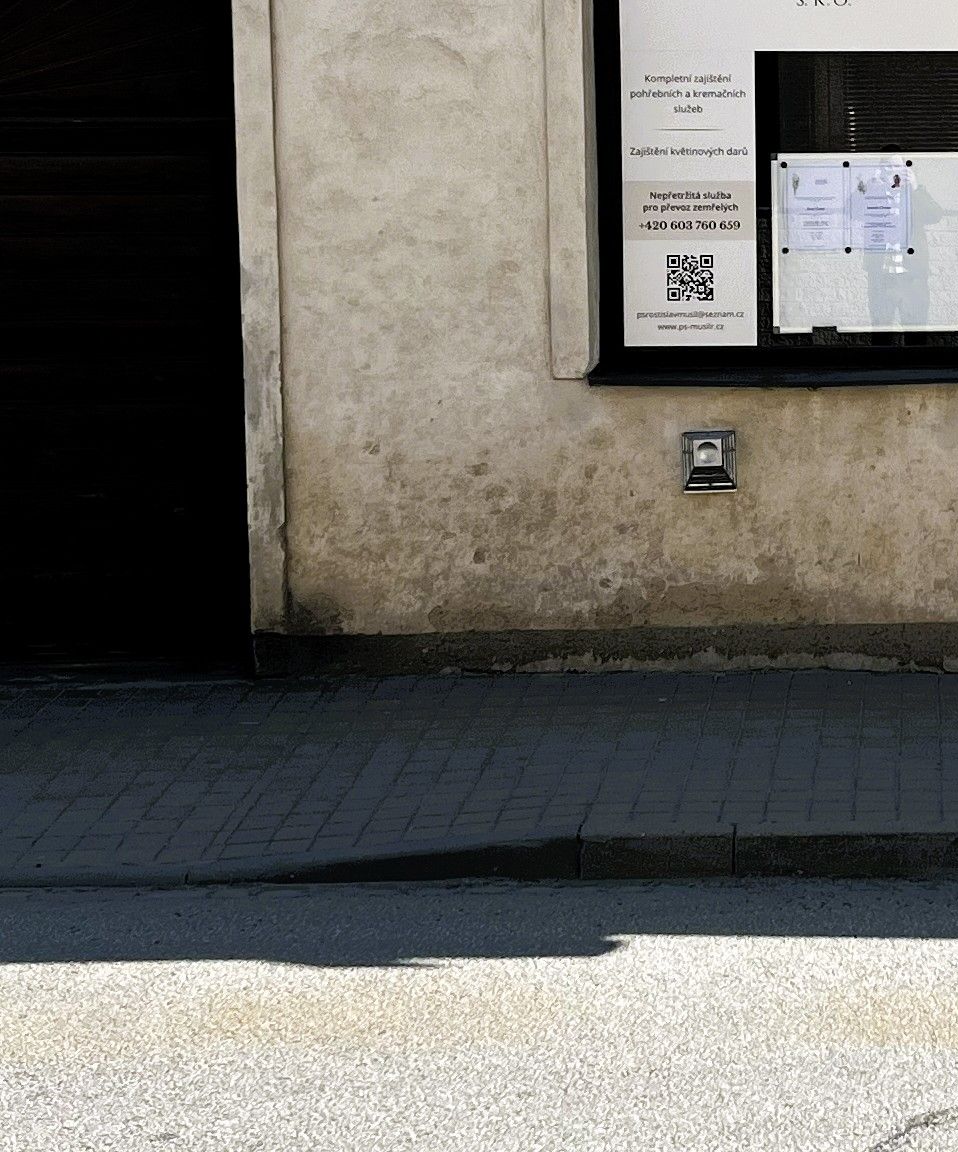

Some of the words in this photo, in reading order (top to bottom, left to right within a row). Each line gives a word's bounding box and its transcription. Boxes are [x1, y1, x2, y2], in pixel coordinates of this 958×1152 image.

[644, 74, 692, 85] Kompletní
[694, 74, 732, 85] zajištění
[630, 89, 682, 99] pohřebních
[693, 89, 746, 98] kremačních
[673, 104, 703, 114] služeb
[629, 147, 668, 157] Zajištění
[670, 147, 724, 158] květinových
[726, 147, 748, 156] darů
[650, 191, 700, 201] Nepřetržitá
[703, 191, 732, 199] služba
[643, 204, 658, 213] pro
[661, 203, 691, 213] převoz
[693, 202, 738, 212] zemřelých
[639, 220, 667, 230] +420
[670, 220, 693, 230] 603
[695, 220, 717, 230] 760
[720, 220, 740, 230] 659
